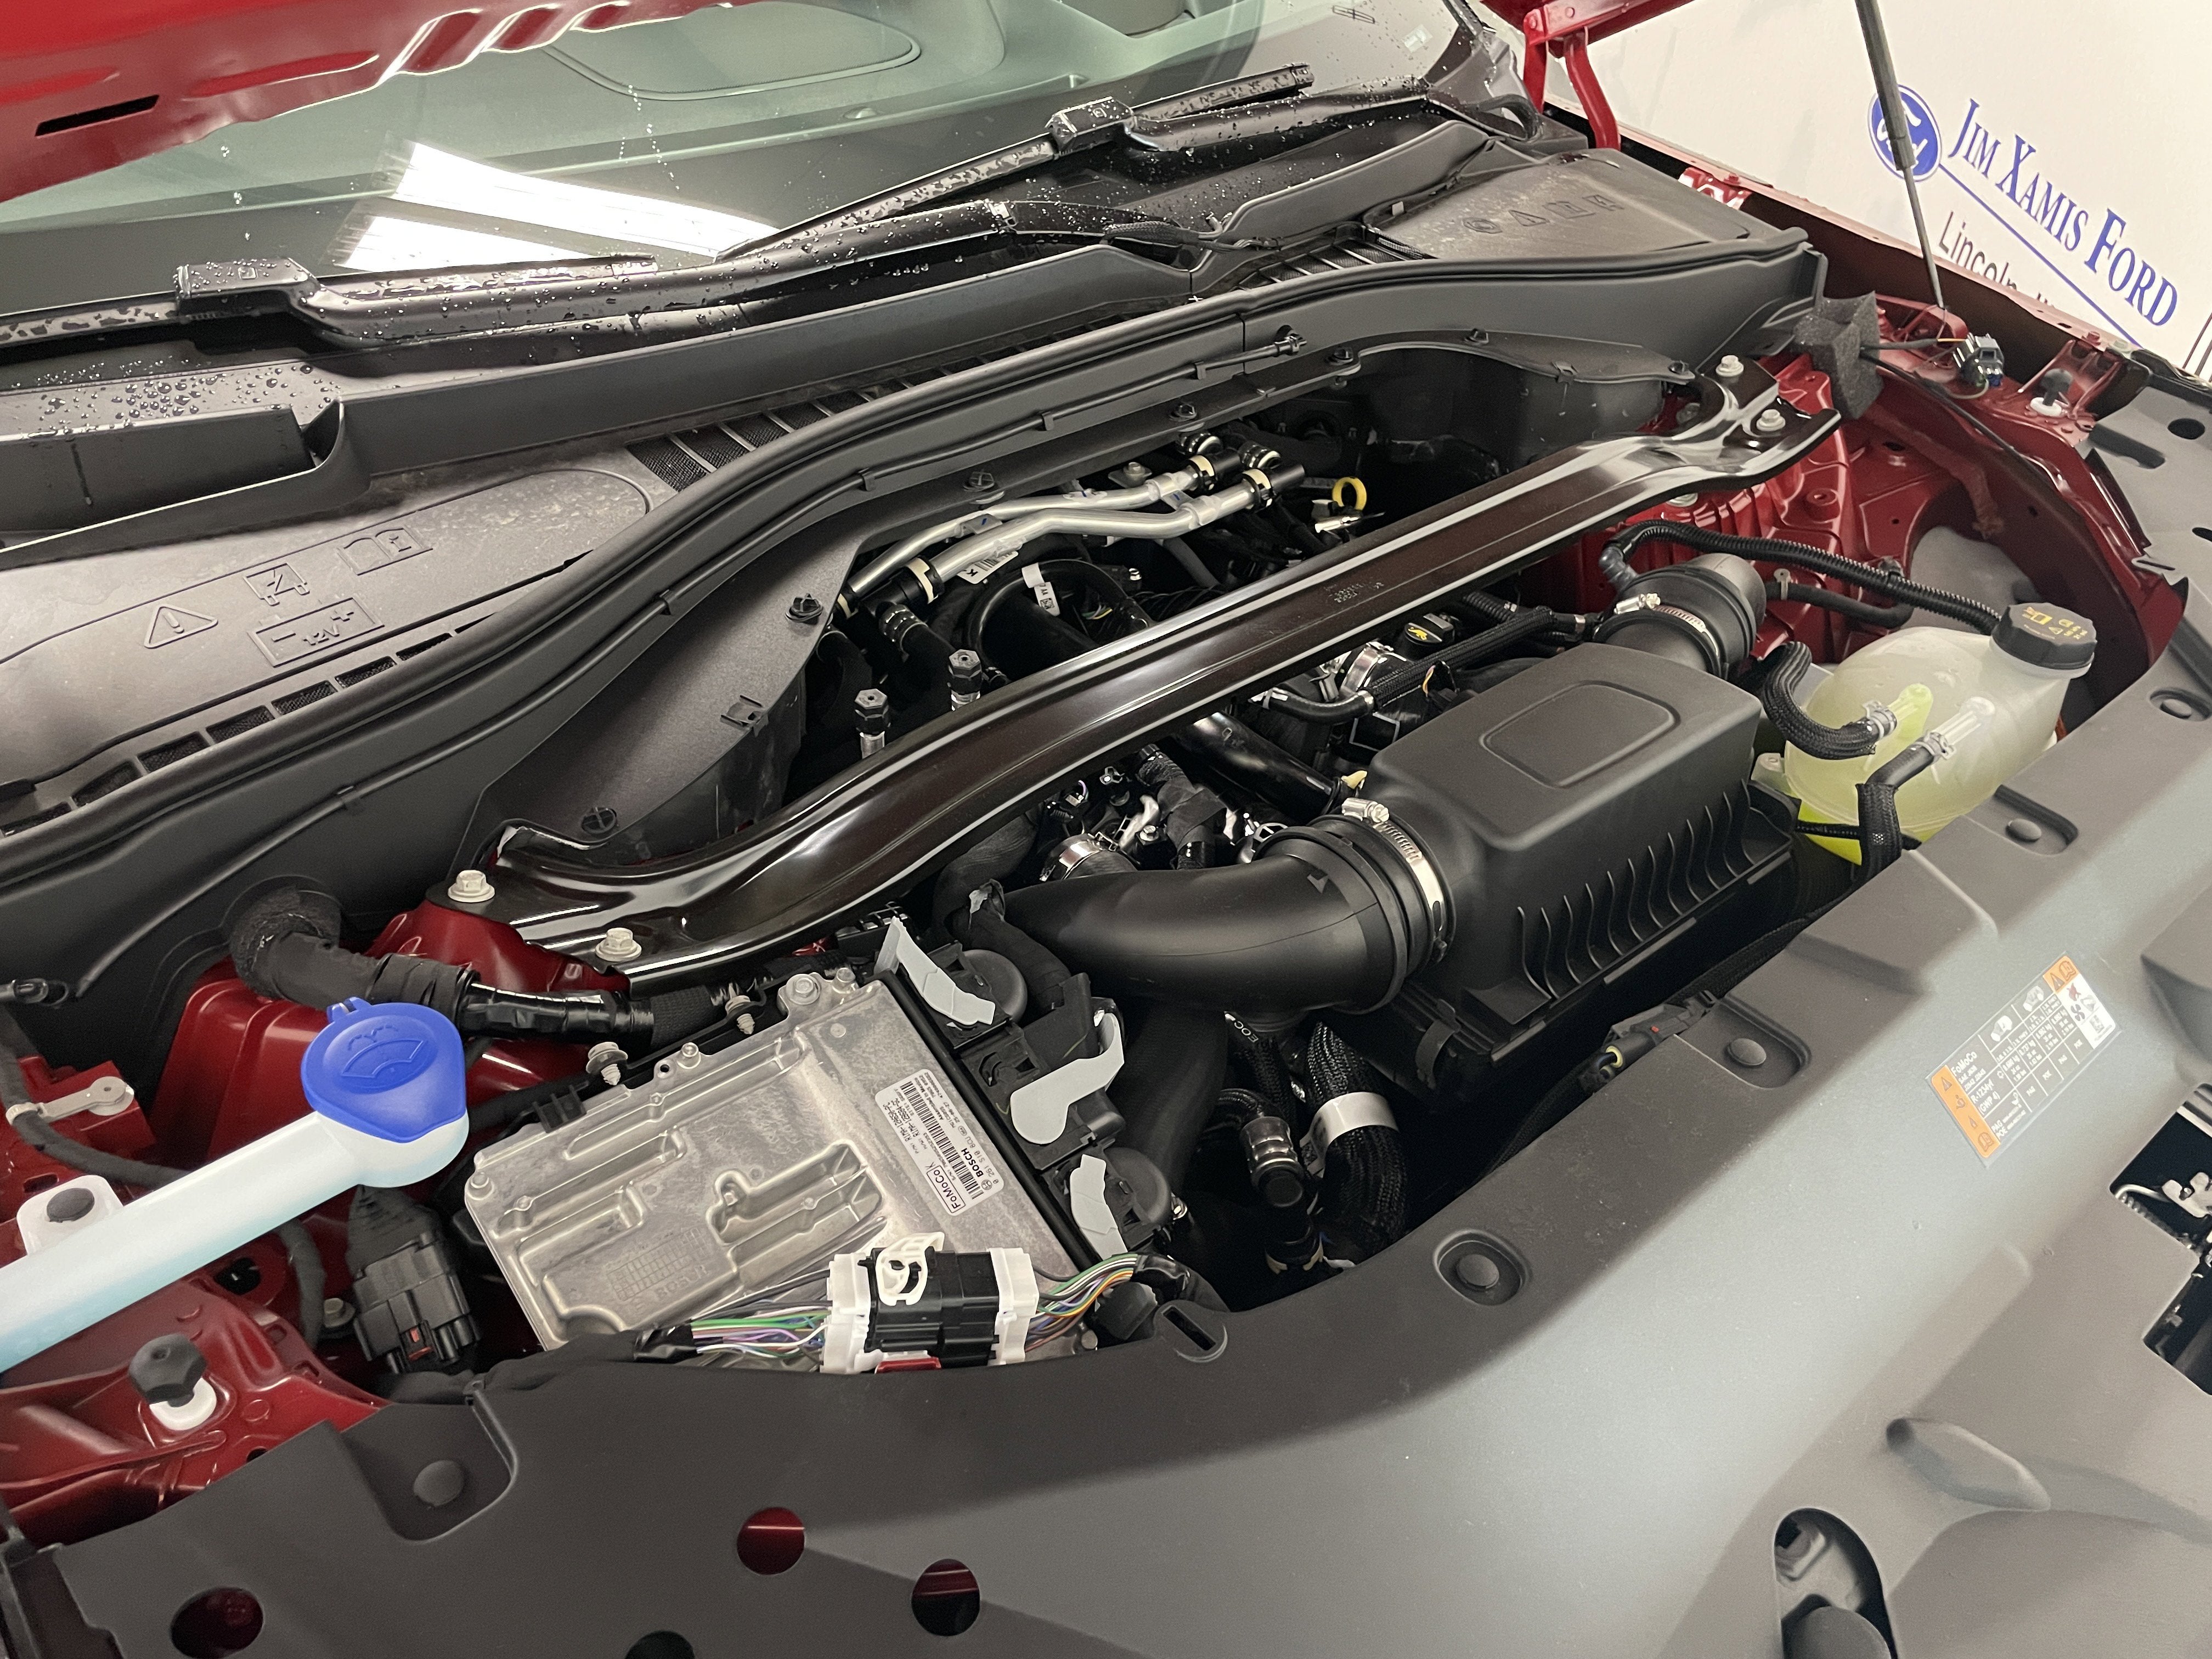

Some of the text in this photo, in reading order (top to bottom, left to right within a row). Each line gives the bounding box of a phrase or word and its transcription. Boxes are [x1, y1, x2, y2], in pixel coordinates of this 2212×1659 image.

[1995, 134, 2089, 251] XAMIS
[2084, 208, 2178, 326] FORD
[302, 623, 340, 646] 12V
[1951, 1052, 1977, 1076] FoMoCo
[915, 1077, 925, 1093] Mexico
[1978, 1096, 1993, 1115] (GWP
[1993, 1091, 2000, 1099] 4)
[1991, 1120, 2003, 1133] PAG
[961, 1148, 983, 1177] BOSCH
[984, 1165, 995, 1177] 261
[934, 1170, 960, 1209] FoMoCo
